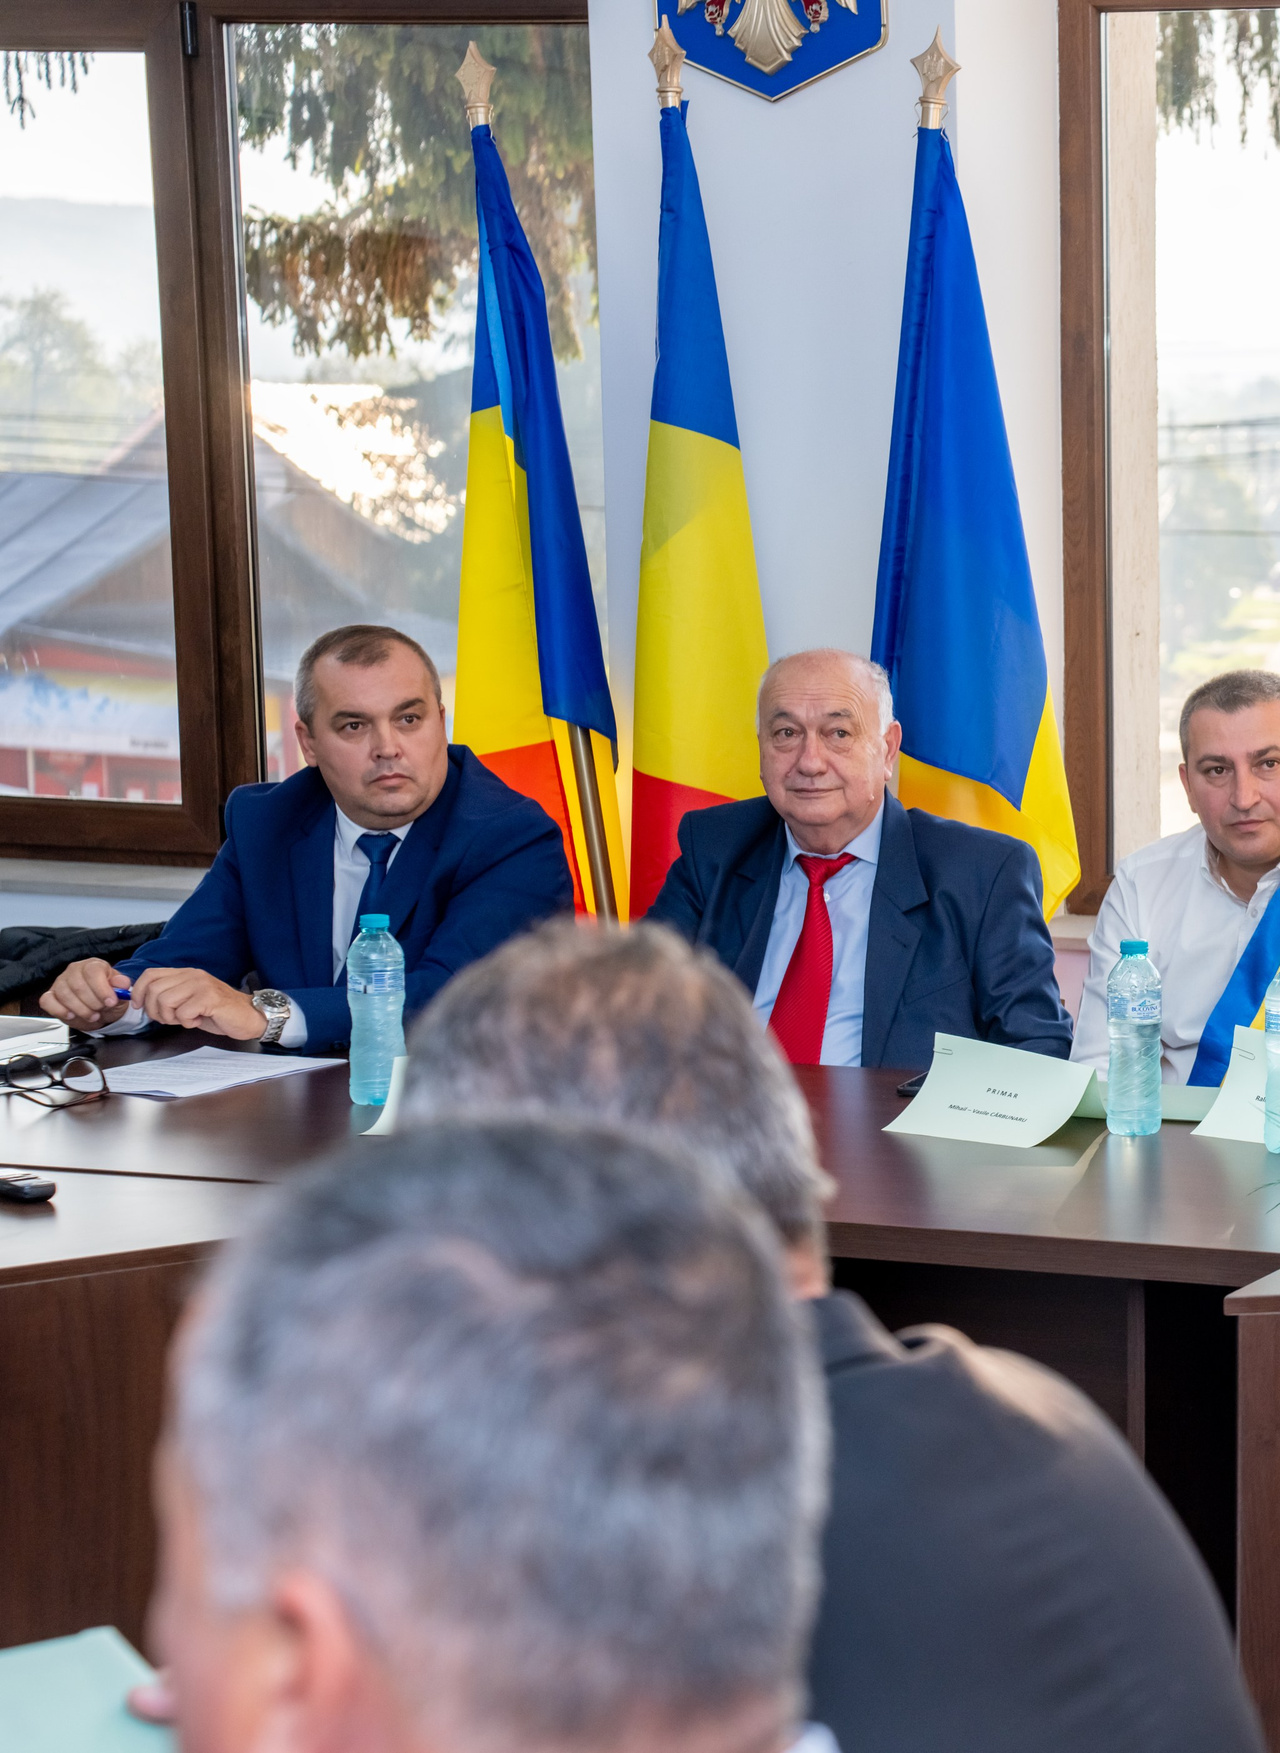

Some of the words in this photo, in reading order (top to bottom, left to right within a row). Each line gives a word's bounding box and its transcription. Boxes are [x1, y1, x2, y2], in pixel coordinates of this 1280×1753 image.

[986, 1087, 1019, 1099] PRIMAR
[948, 1104, 968, 1112] Mihail
[972, 1108, 989, 1116] Vasile
